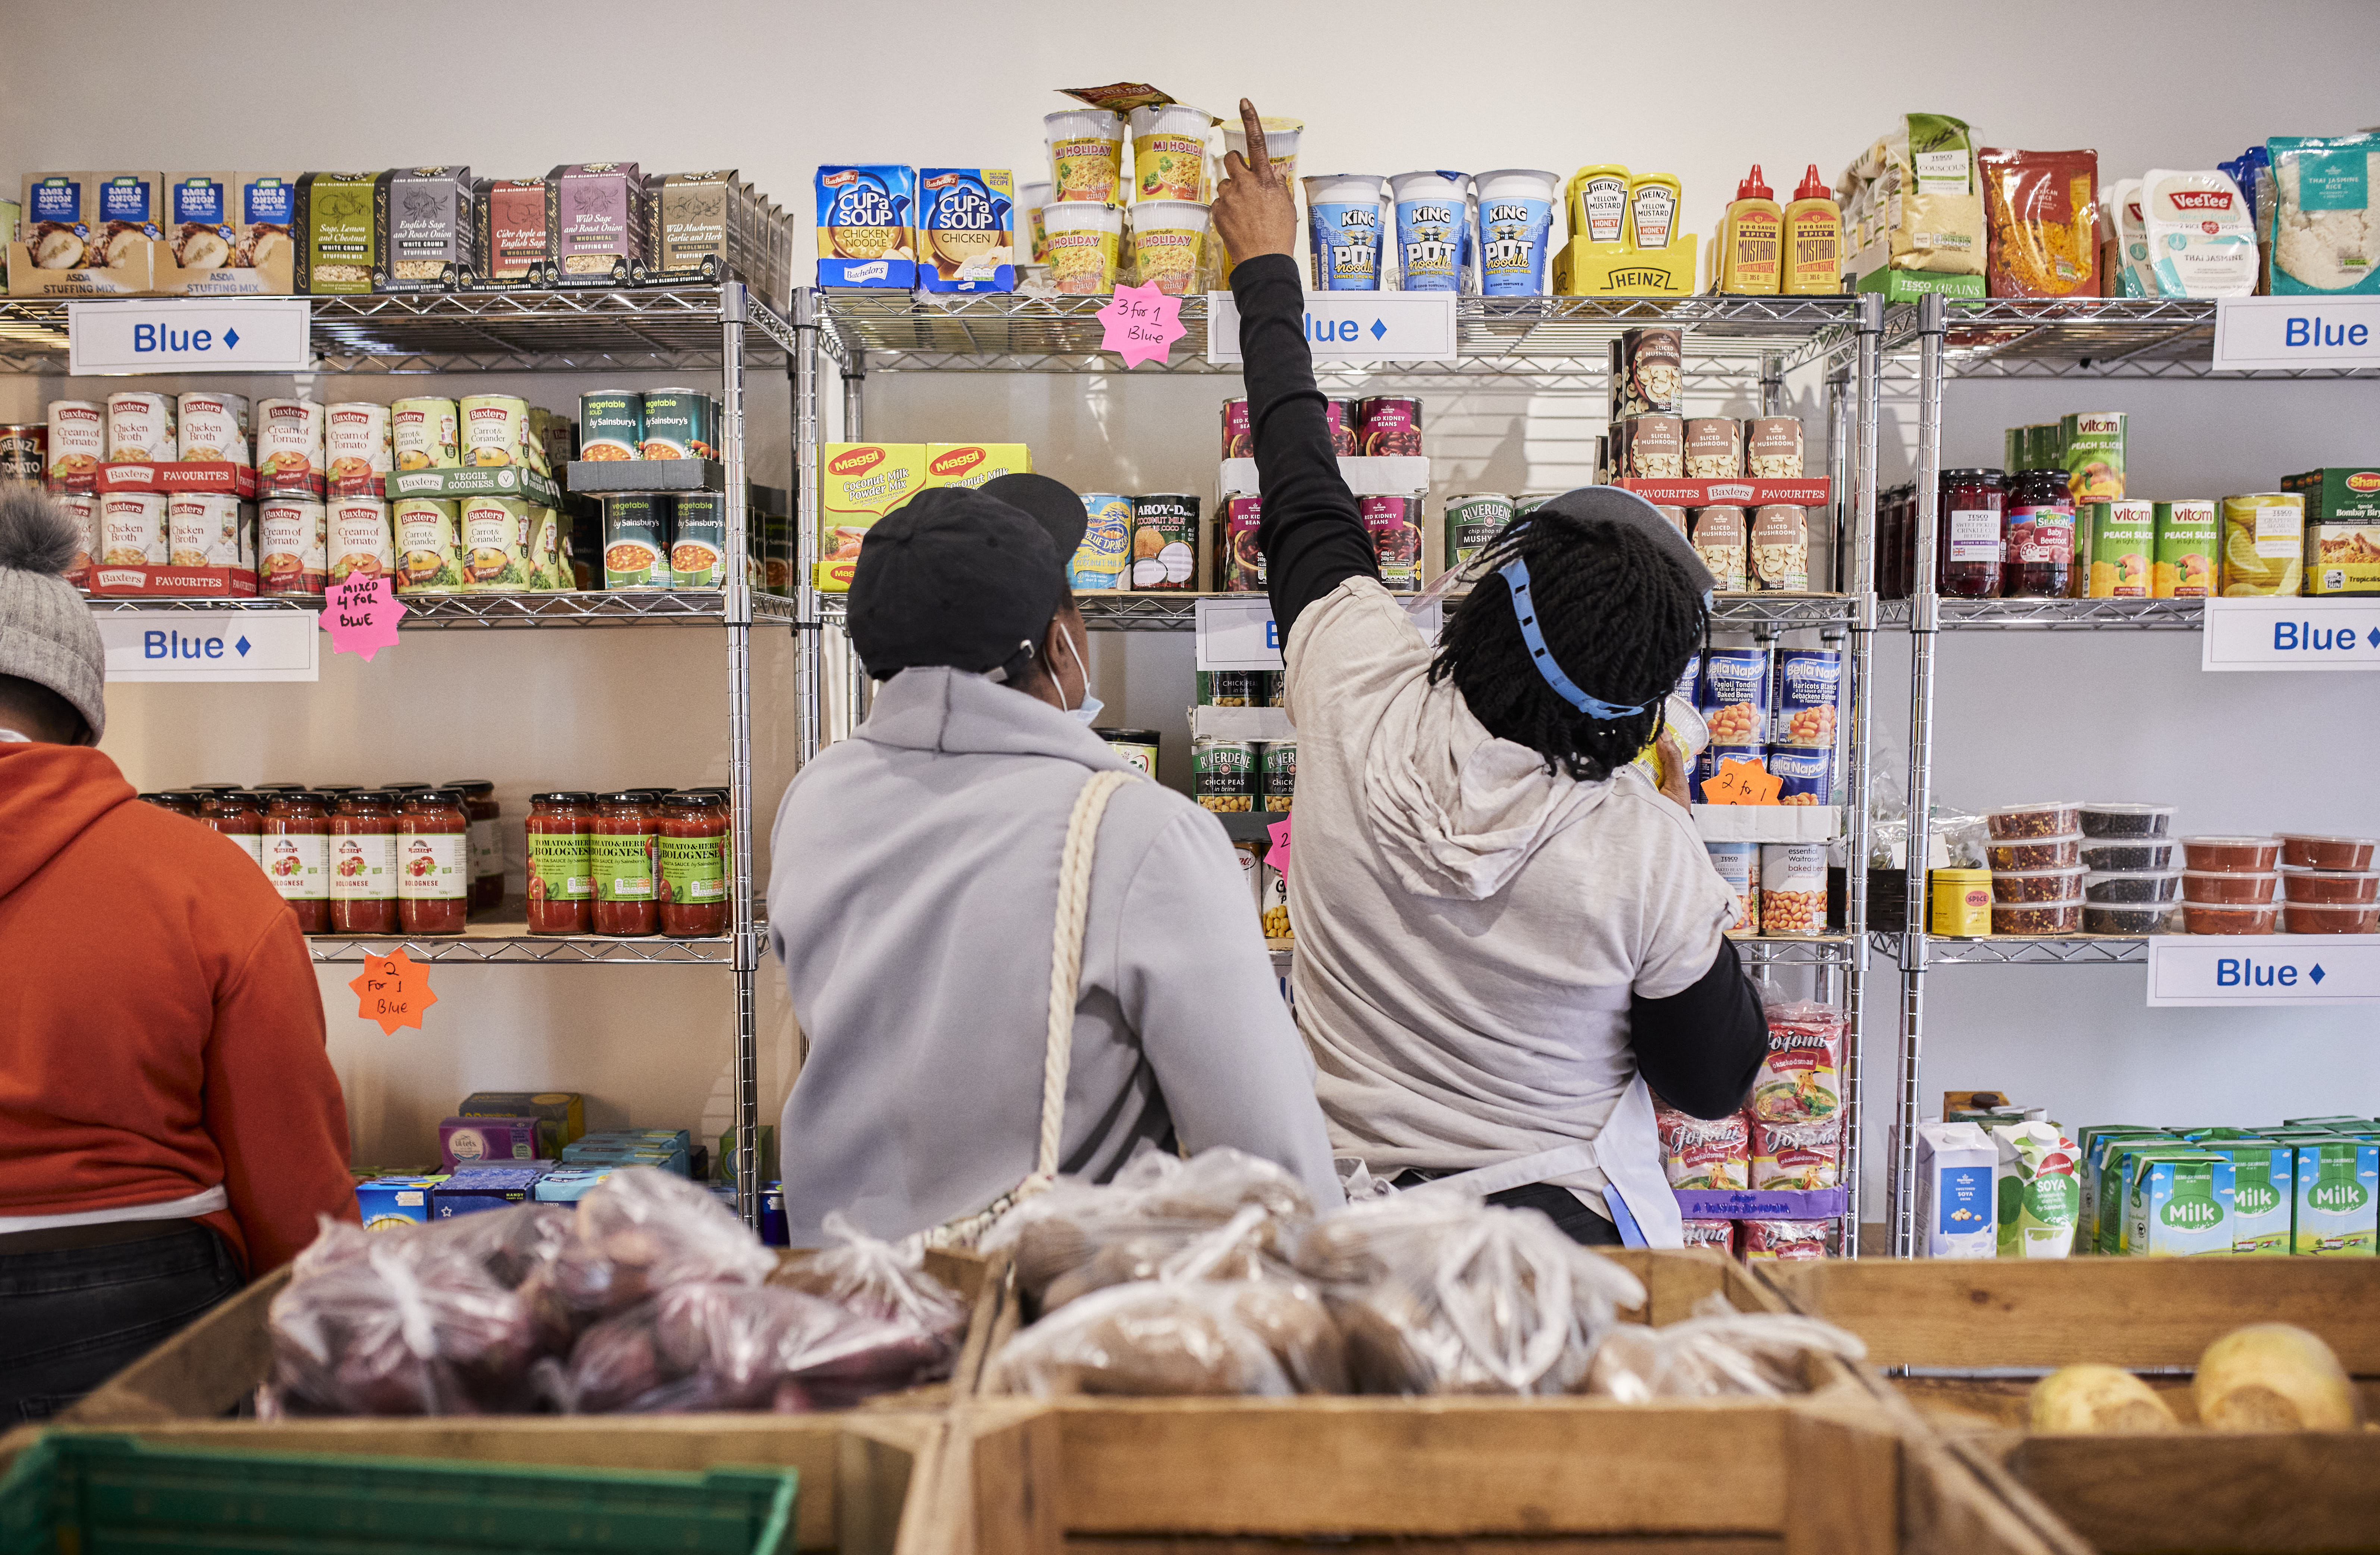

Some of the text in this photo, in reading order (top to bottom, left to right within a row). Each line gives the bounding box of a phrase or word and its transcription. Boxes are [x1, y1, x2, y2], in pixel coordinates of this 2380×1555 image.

[1055, 145, 1112, 159] MI HOLIDAY
[1919, 164, 1966, 172] COUSCOUS
[824, 173, 856, 185] Batchelors
[1593, 183, 1618, 192] HEINZ
[2173, 194, 2228, 208] VeeTee
[839, 210, 893, 226] SOUP
[1489, 205, 1527, 223] KING
[400, 220, 445, 229] English Sage
[666, 224, 722, 233] Wild Mushroom,
[318, 233, 332, 242] and
[393, 230, 452, 238] and Roast Onion
[667, 233, 688, 242] Garlic
[690, 233, 703, 242] and
[843, 229, 889, 238] CHICKEN
[941, 234, 990, 243] CHICKEN
[1484, 239, 1533, 264] POT
[1738, 240, 1776, 264] MUSTARD
[1486, 253, 1529, 269] noodle
[1760, 264, 1772, 272] STYLE
[66, 273, 90, 282] ASDA
[1616, 272, 1664, 287] HEINZ
[44, 284, 116, 293] STUFFING MIX
[1901, 280, 1980, 295] TESCO GRAINS
[1117, 299, 1128, 315] 3
[1131, 301, 1148, 318] for
[1305, 312, 1359, 342] lue
[2286, 317, 2368, 346] Blue
[134, 323, 212, 351] Blue
[1128, 326, 1163, 343] Blue
[589, 400, 625, 409] vegetable
[60, 410, 97, 420] Baxters
[114, 424, 147, 433] Chicken
[590, 418, 636, 428] by Sainsbury's
[57, 428, 100, 437] Cream of
[117, 433, 142, 441] Broth
[60, 437, 97, 446] Tomato
[835, 450, 879, 472] Maggi
[110, 468, 229, 480] Baxters FAVOURITES
[843, 468, 909, 492] Coconut Milk
[402, 477, 439, 488] Baxters
[448, 480, 493, 489] GOODNESS
[849, 480, 906, 501] Powder Mix
[1138, 505, 1184, 516] AROY-D
[1461, 504, 1511, 522] RIVERDENE
[1137, 516, 1167, 525] COCONUT
[2047, 528, 2062, 537] Baby
[1085, 533, 1128, 550] BLUE DRAGON
[344, 582, 378, 594] MIXED
[337, 596, 348, 610] 4
[340, 613, 373, 626] BLUE
[2274, 621, 2356, 650] Blue
[144, 630, 224, 659] Blue
[1200, 752, 1251, 769] RIVERDENE
[1722, 773, 1734, 788] 2
[1280, 833, 1291, 848] 2
[662, 850, 719, 859] BOLOGNESE
[383, 962, 400, 976] 2
[2217, 958, 2298, 986] Blue
[368, 980, 402, 993] For 1
[376, 999, 408, 1014] Blue
[2039, 1161, 2071, 1174] Unsweetened
[2037, 1179, 2066, 1191] SOYA
[2170, 1202, 2215, 1222] Milk
